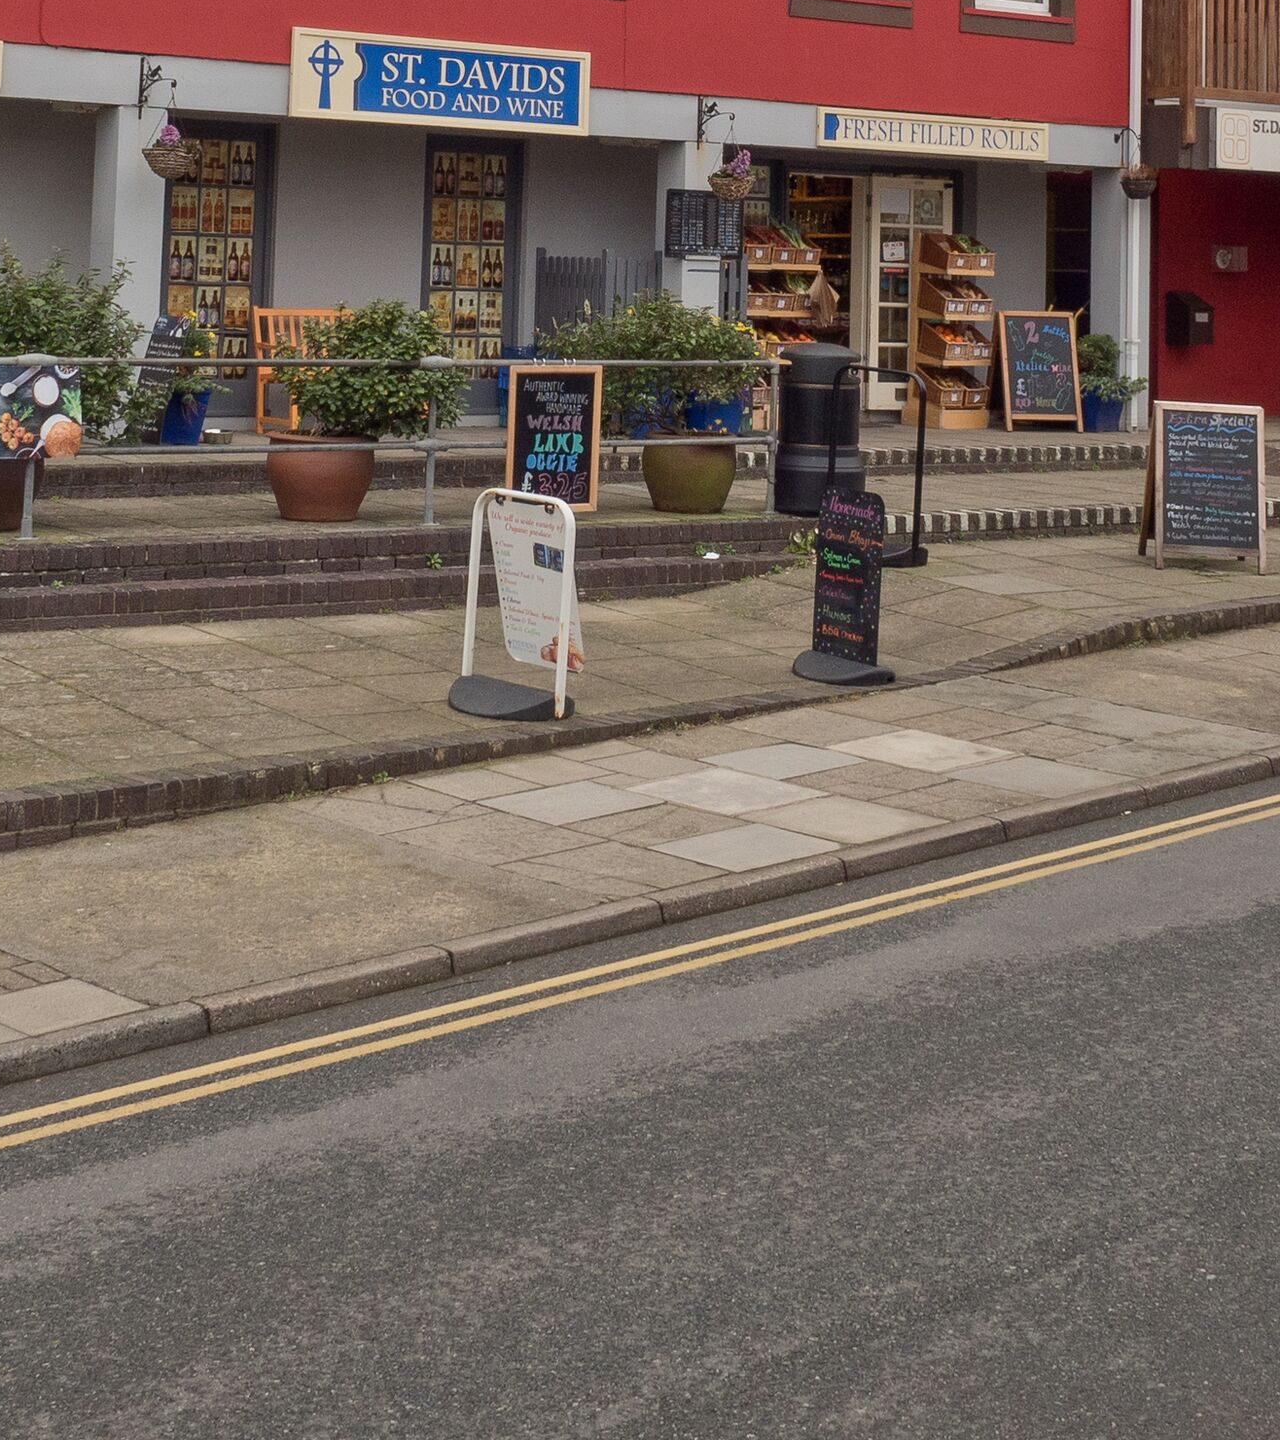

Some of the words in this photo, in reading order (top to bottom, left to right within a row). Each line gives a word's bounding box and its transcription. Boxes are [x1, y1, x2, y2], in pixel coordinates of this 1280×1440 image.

[381, 52, 426, 85] ST.
[439, 57, 565, 95] DAVIDS
[381, 87, 446, 110] FOOD
[451, 94, 500, 114] AND
[506, 97, 564, 119] WINE
[843, 118, 903, 143] FRESH
[910, 122, 974, 147] FILLED
[981, 128, 1040, 152] ROLLS
[1024, 321, 1040, 344] 2
[524, 379, 565, 392] AUTHENTIC
[536, 392, 559, 402] AWARD
[559, 393, 589, 405] WINNING
[546, 403, 582, 415] HANDMADE
[527, 414, 584, 432] WELSH
[1209, 414, 1255, 433] Specials
[533, 432, 584, 454] LAMB
[526, 453, 578, 472] OGGIE
[492, 511, 502, 520] We
[504, 514, 514, 522] sell
[521, 518, 535, 526] wide
[536, 521, 555, 532] variety
[556, 523, 564, 533] of
[529, 530, 552, 539] produce
